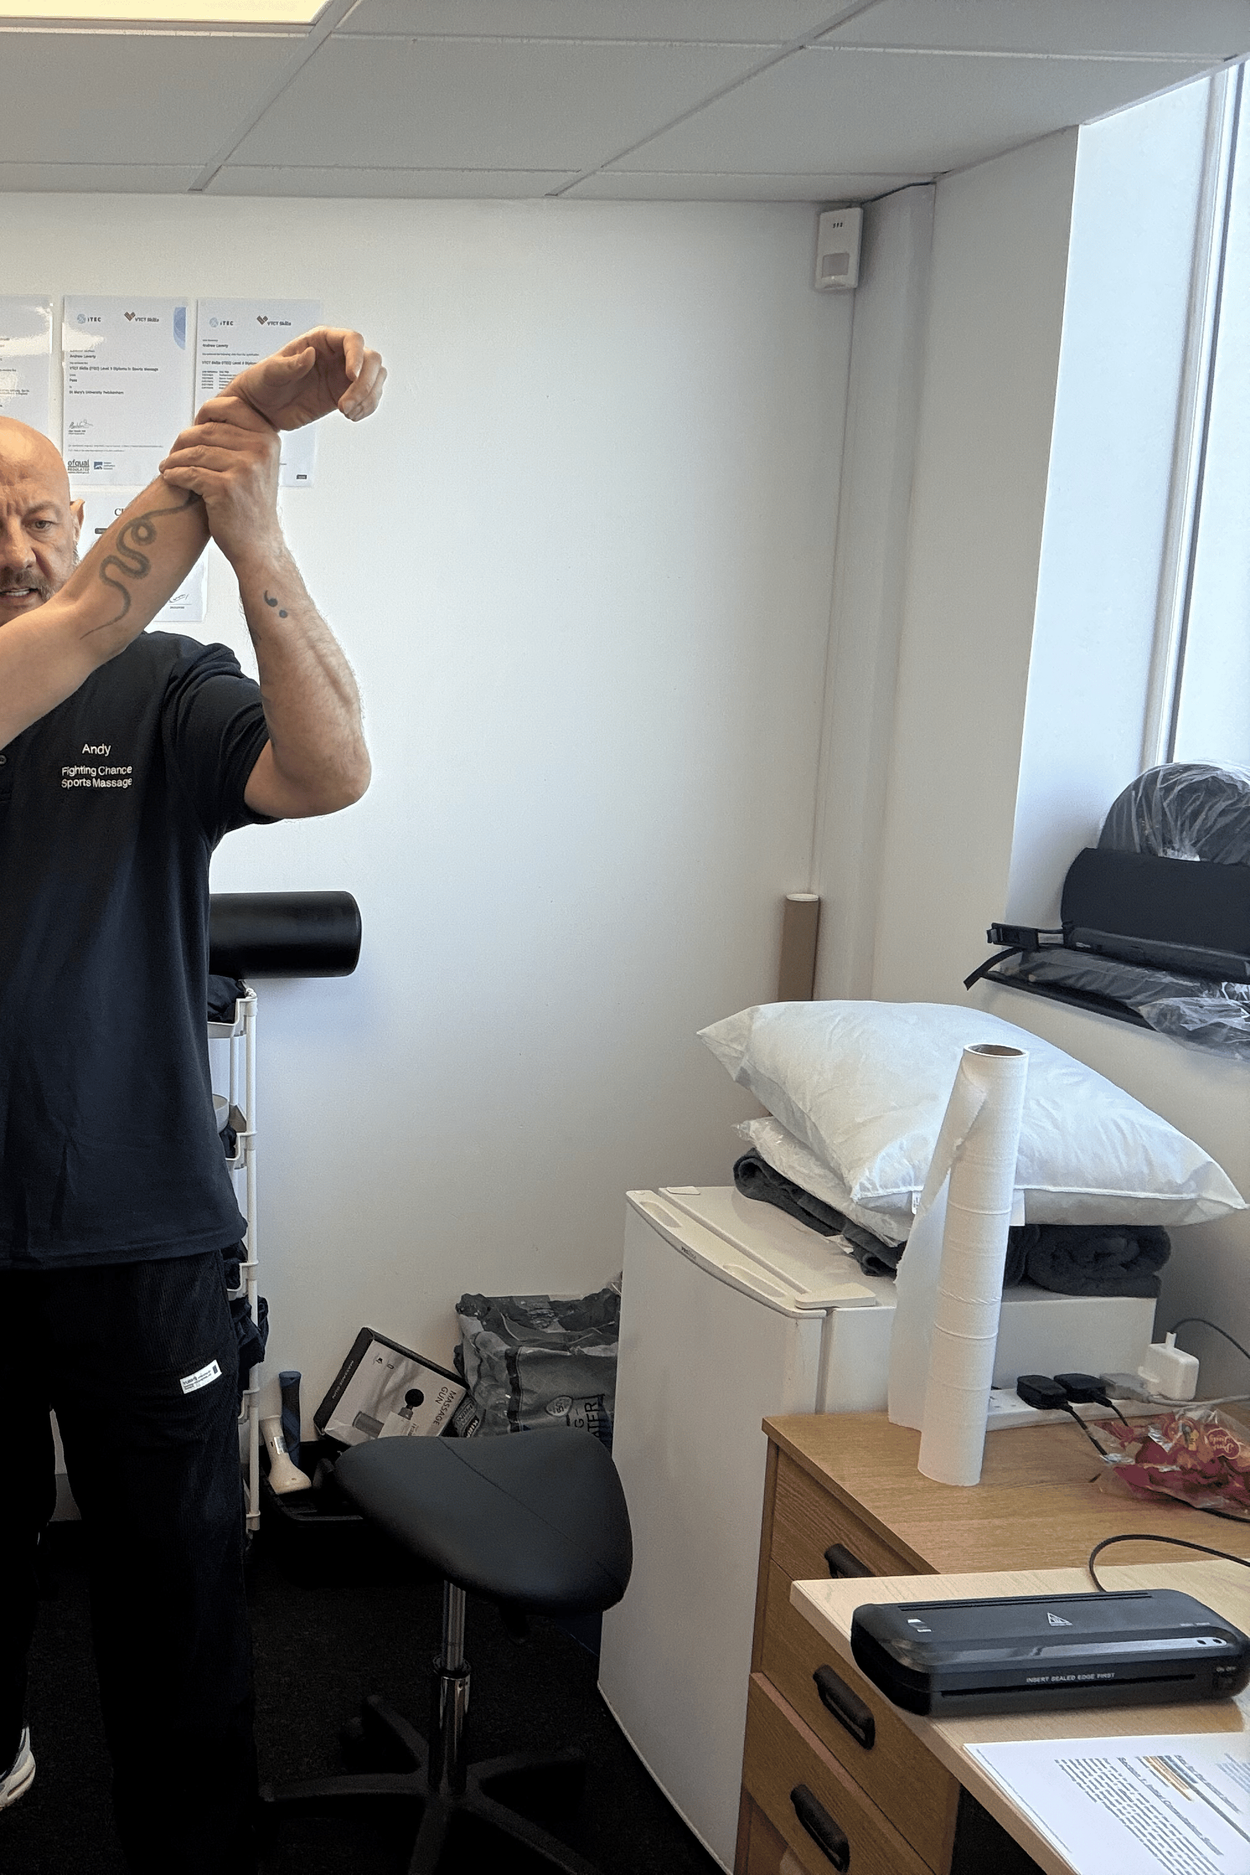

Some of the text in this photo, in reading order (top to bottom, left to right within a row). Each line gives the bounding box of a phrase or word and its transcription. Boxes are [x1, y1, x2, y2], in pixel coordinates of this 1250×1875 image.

[82, 743, 111, 757] Andy
[61, 765, 133, 777] Fighting Chance
[61, 777, 133, 789] Sports Massage
[435, 1386, 449, 1405] GUN
[432, 1390, 457, 1426] MASSAGE
